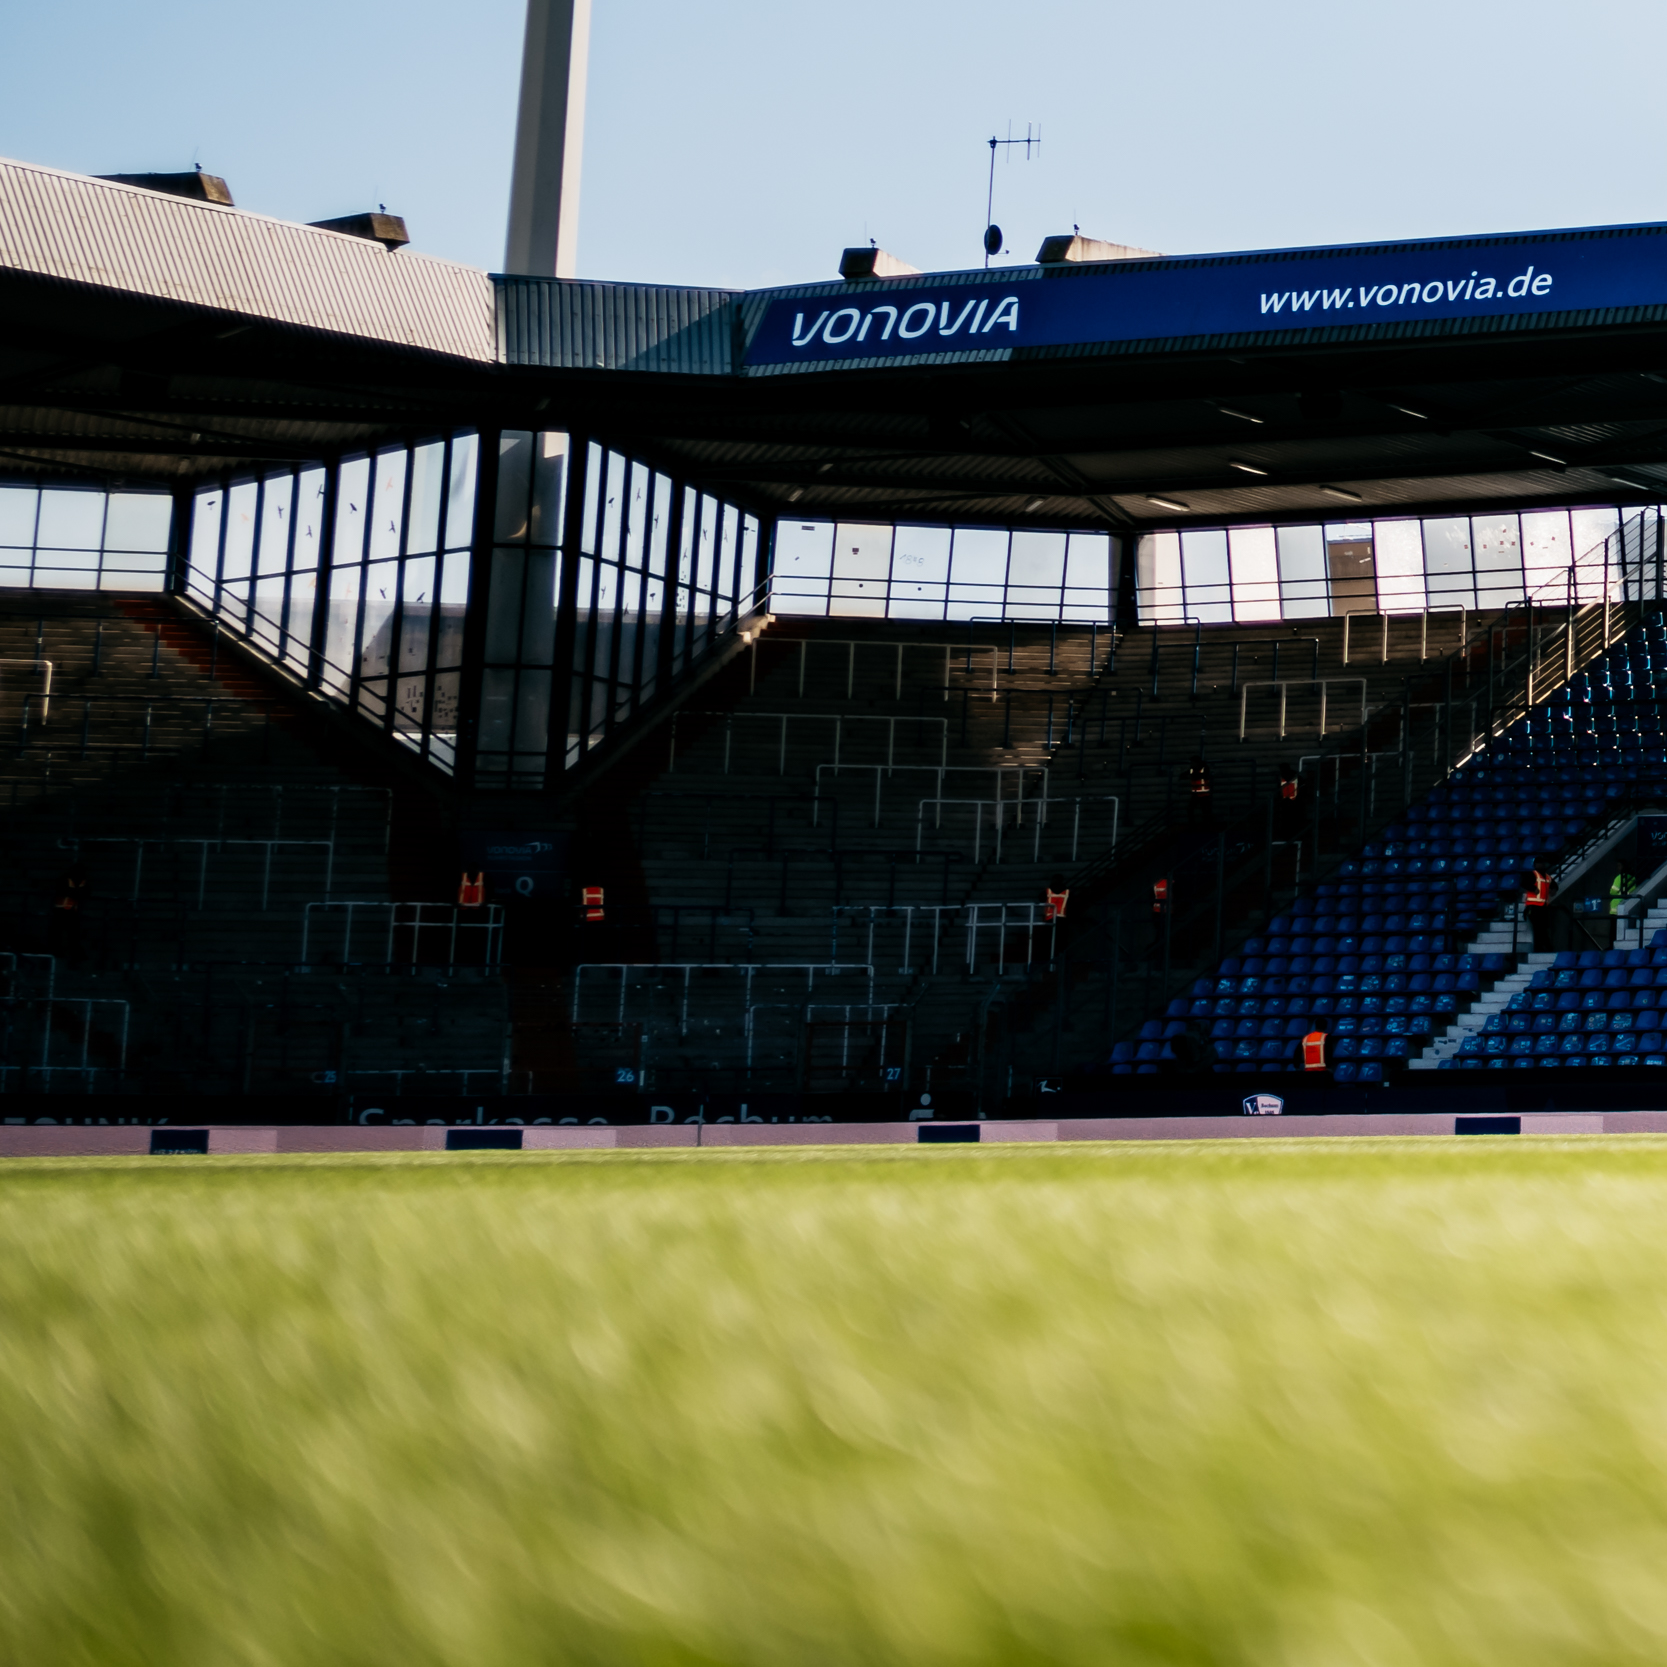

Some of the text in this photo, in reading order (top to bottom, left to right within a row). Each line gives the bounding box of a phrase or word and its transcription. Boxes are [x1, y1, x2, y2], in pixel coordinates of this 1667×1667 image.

[1260, 265, 1553, 314] www.vonovia.de
[792, 296, 1019, 347] VONOVIA
[515, 877, 534, 897] Q
[617, 1069, 634, 1082] 26
[887, 1068, 900, 1080] 27
